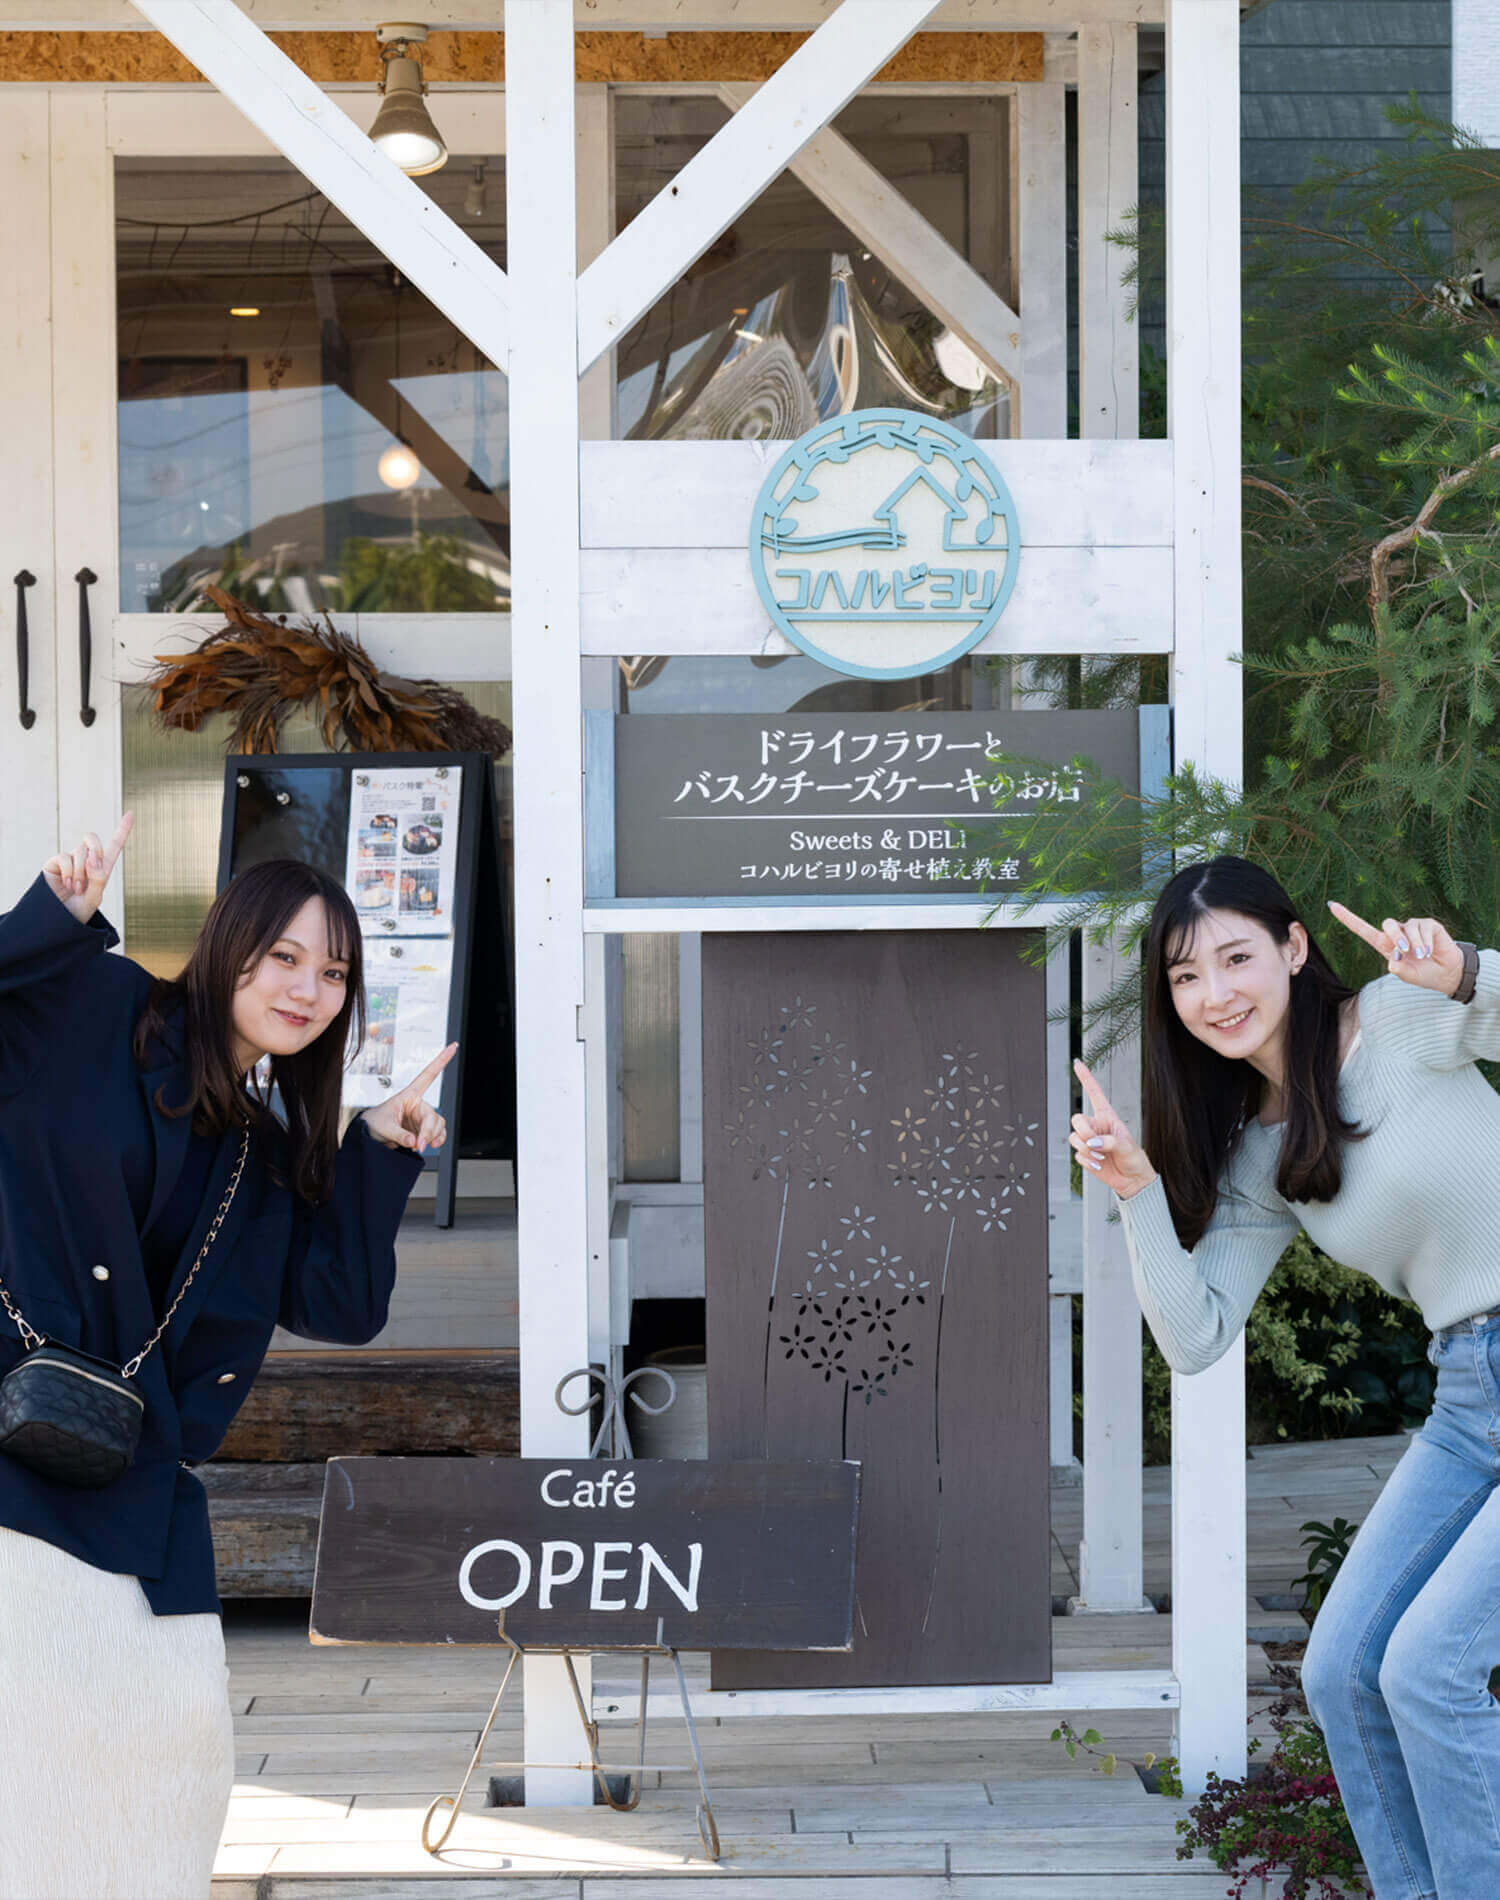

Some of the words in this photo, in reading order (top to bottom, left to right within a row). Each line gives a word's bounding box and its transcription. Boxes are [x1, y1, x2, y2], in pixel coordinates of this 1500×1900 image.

[775, 562, 995, 610] コハルビヨリ
[760, 729, 1002, 765] ドライフラワーと
[790, 830, 873, 851] Sweets
[880, 829, 902, 850] &
[739, 856, 1021, 883] コハルビヨリの寄せ植え教室
[540, 1468, 636, 1509] Café
[458, 1538, 703, 1613] OPEN
